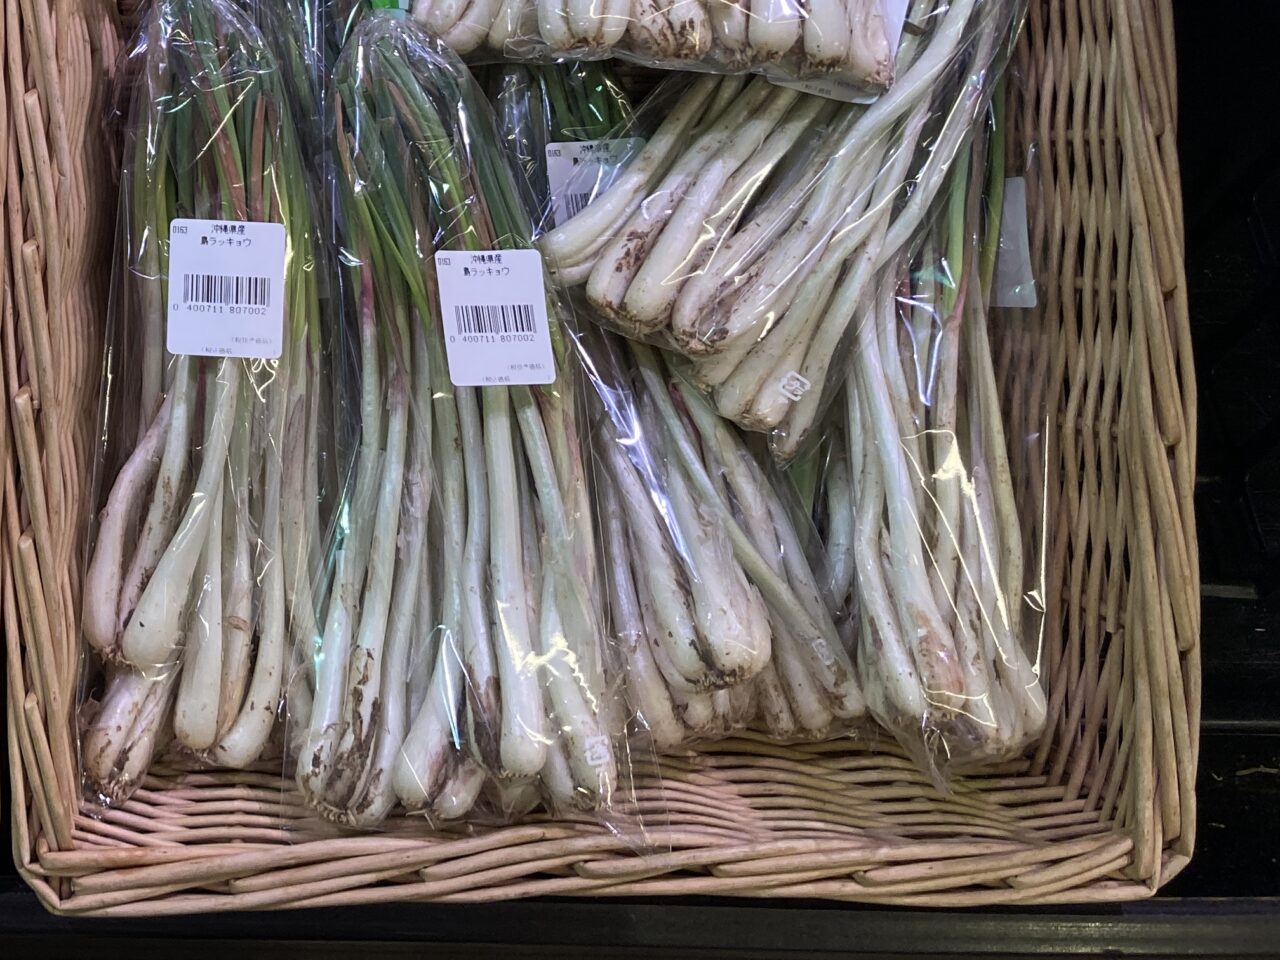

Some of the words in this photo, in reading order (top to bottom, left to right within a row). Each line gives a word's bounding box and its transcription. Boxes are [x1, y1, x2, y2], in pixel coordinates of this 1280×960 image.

[211, 225, 245, 234] 沖縄県産
[200, 236, 252, 247] 島ラッキョウ
[471, 254, 502, 264] 沖縄県産
[464, 267, 509, 276] 島ラッキョウ
[187, 305, 223, 313] 400711
[230, 305, 266, 315] 807002
[463, 335, 495, 343] 400711
[501, 334, 535, 343] 807002
